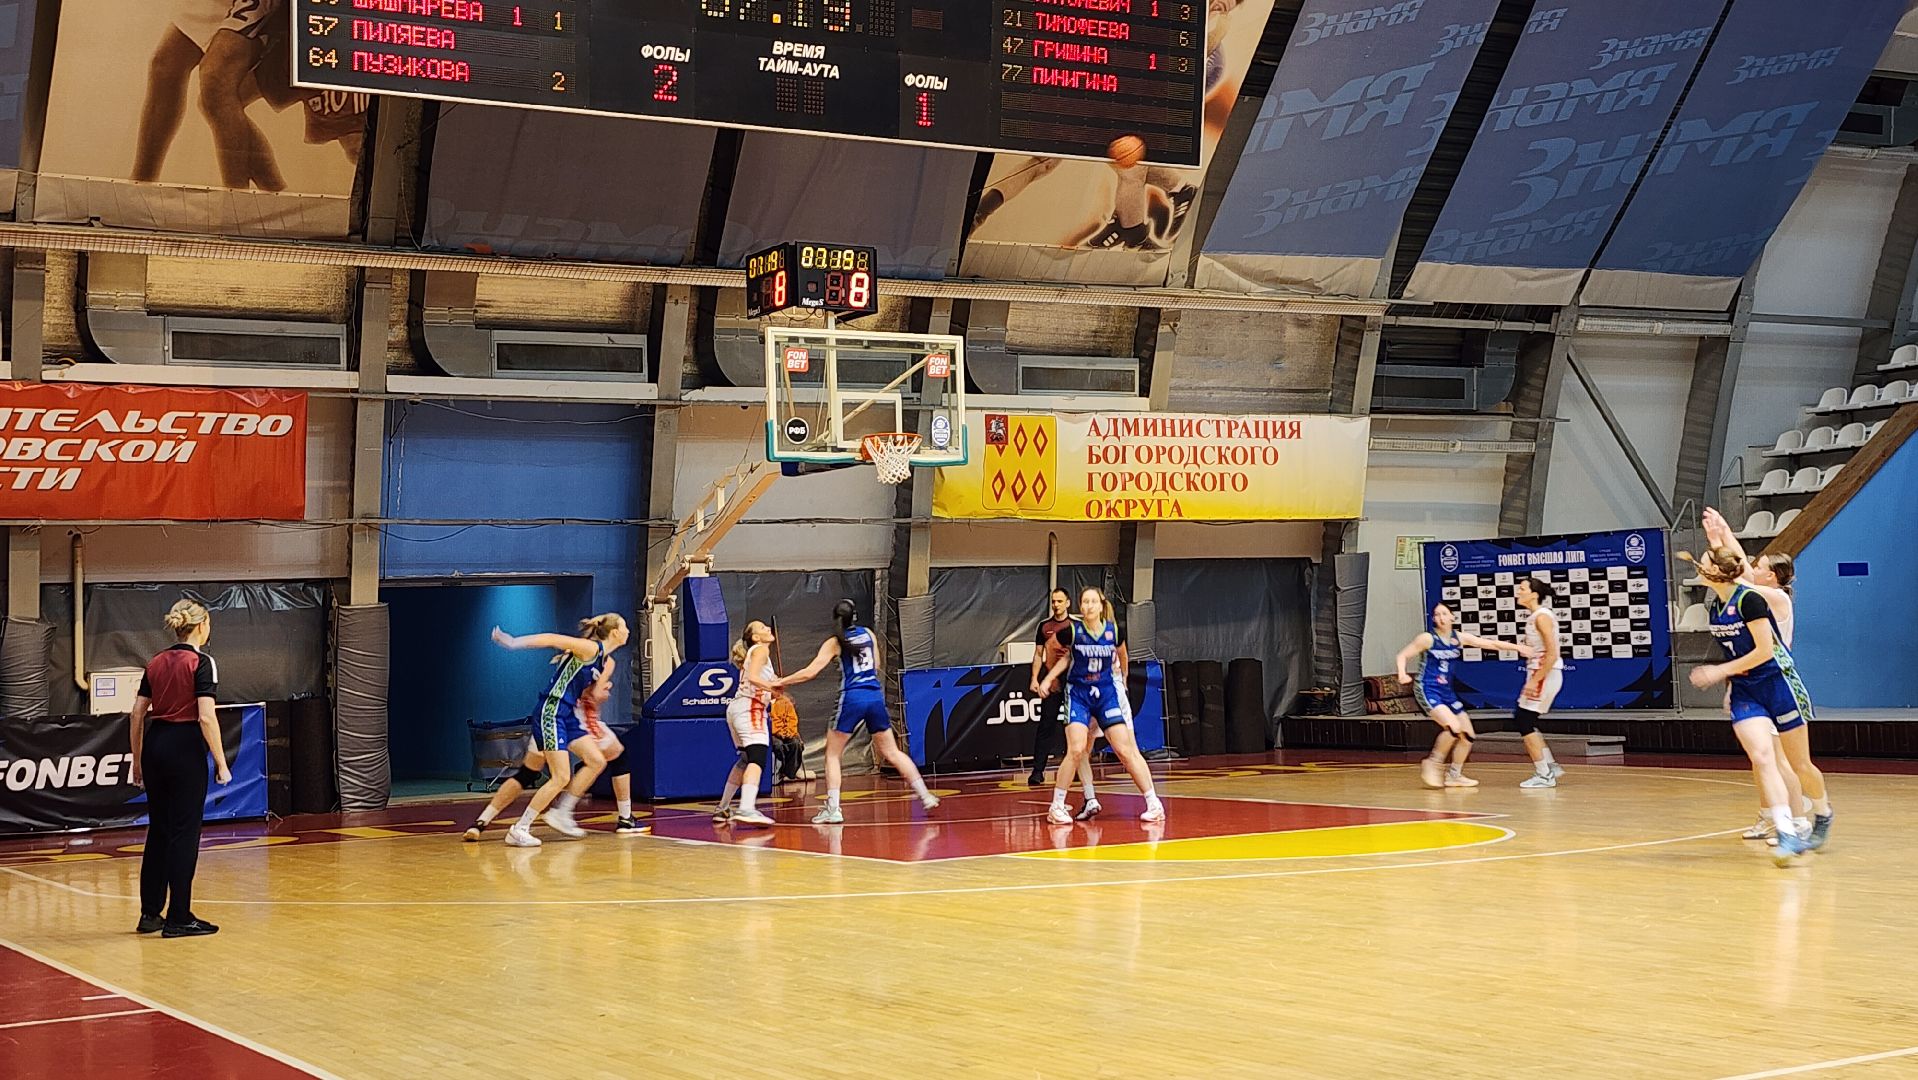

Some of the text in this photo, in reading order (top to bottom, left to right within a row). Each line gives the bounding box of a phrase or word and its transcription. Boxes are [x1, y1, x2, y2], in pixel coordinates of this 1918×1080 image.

[513, 6, 523, 27] 1
[554, 11, 563, 31] 1
[1003, 9, 1190, 47] 21 ТИМОФЕЕВА 6
[308, 14, 456, 50] 57 ПИЛЯЕВА
[641, 44, 691, 63] ФОЛЫ
[772, 40, 826, 60] ВРЕМЯ
[1002, 36, 1188, 73] 47 ГРИШИНА 1 3
[308, 46, 565, 91] 64 ПУЗИКОВА 2
[758, 56, 841, 80] ТАЙМ-АУТА
[1001, 63, 1117, 93] 77 ПИНИГИНА
[653, 64, 679, 102] 2
[904, 72, 949, 91] ФОЛЫ
[914, 92, 933, 127] 1
[848, 271, 869, 308] 8
[786, 351, 807, 360] FON
[786, 360, 807, 369] BET
[928, 357, 948, 366] FON
[928, 366, 948, 375] BET
[1086, 417, 1303, 443] АДМИНИСТРАЦИЯ
[0, 435, 198, 464] ВСКОЙ
[1087, 444, 1279, 469] БОГОРОДСКОГО
[0, 466, 83, 491] ТИ
[1086, 471, 1248, 496] ГОРОДСКОГО
[1085, 498, 1184, 519] ОКРУГА
